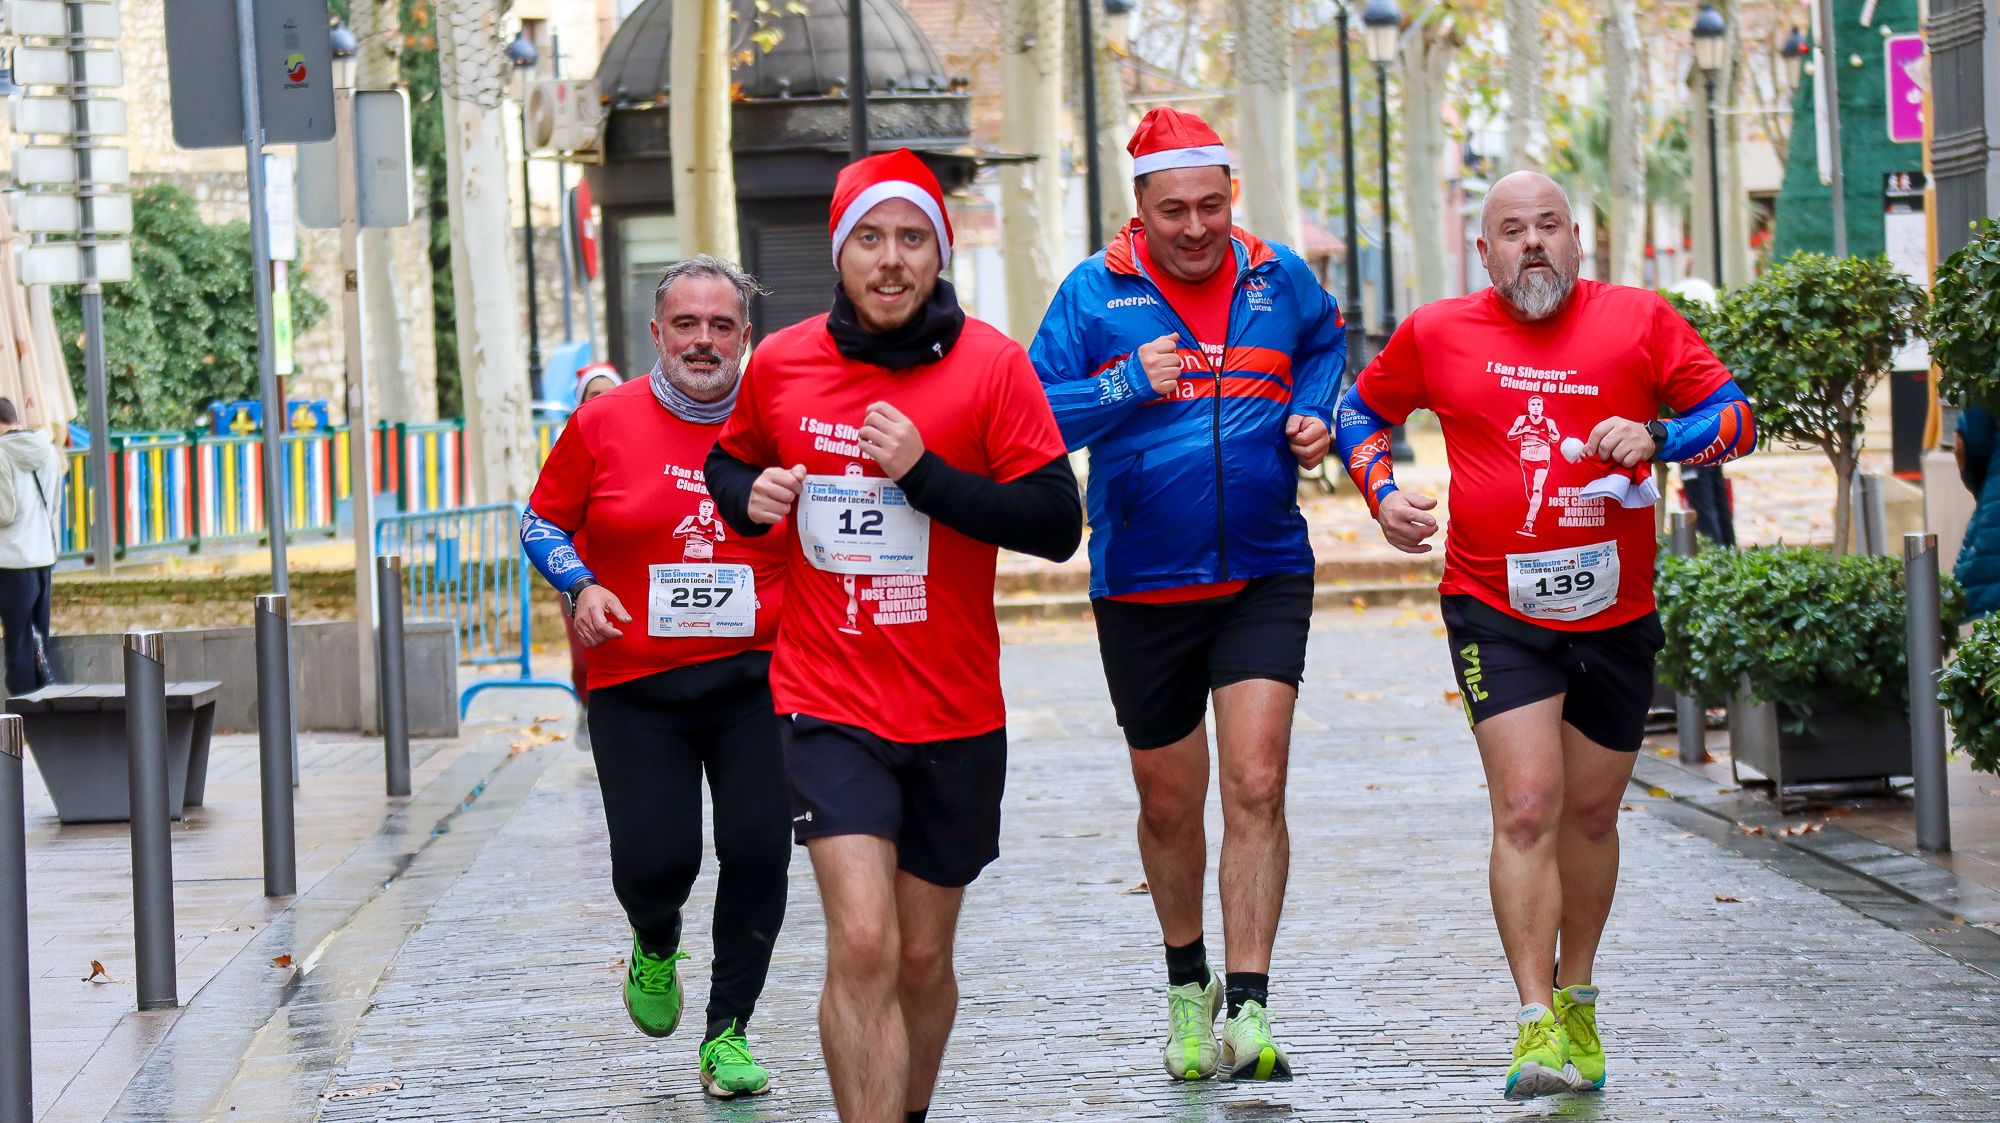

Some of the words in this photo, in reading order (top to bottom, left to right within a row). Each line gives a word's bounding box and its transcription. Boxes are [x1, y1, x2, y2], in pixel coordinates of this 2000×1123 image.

[1246, 290, 1263, 298] Club
[1485, 361, 1494, 373] I
[1494, 362, 1516, 377] San
[1517, 365, 1567, 380] Silvestre
[1500, 376, 1541, 393] Ciudad
[1541, 381, 1557, 393] de
[1558, 382, 1599, 396] Lucena
[1340, 411, 1357, 419] Club
[799, 416, 808, 432] I
[807, 418, 834, 437] San
[833, 423, 861, 442] Silv
[1340, 420, 1368, 428] Lucena
[814, 435, 861, 458] Ciudad
[663, 464, 671, 475] I
[671, 465, 692, 479] San
[676, 478, 710, 496] Ciuda
[812, 486, 826, 494] San
[827, 487, 859, 496] Silvestre
[1557, 487, 1585, 497] MEM
[811, 494, 836, 502] Ciudad
[837, 495, 847, 503] de
[848, 497, 875, 505] Lucena
[1547, 496, 1570, 507] JOSE
[1564, 506, 1605, 517] HURTADO
[838, 509, 884, 536] 12
[1558, 516, 1605, 527] MARJALIZO
[879, 553, 914, 561] enerplus
[1532, 560, 1561, 568] Silvestre
[1552, 565, 1576, 573] Lucena
[871, 575, 926, 589] MEMORIAL
[1535, 571, 1595, 597] 139
[670, 587, 734, 608] 257
[860, 588, 886, 601] JOSE
[886, 585, 927, 600] CARLOS
[879, 597, 927, 613] HURTADO
[873, 609, 928, 626] MARJALIZO
[1460, 643, 1489, 703] FILA
